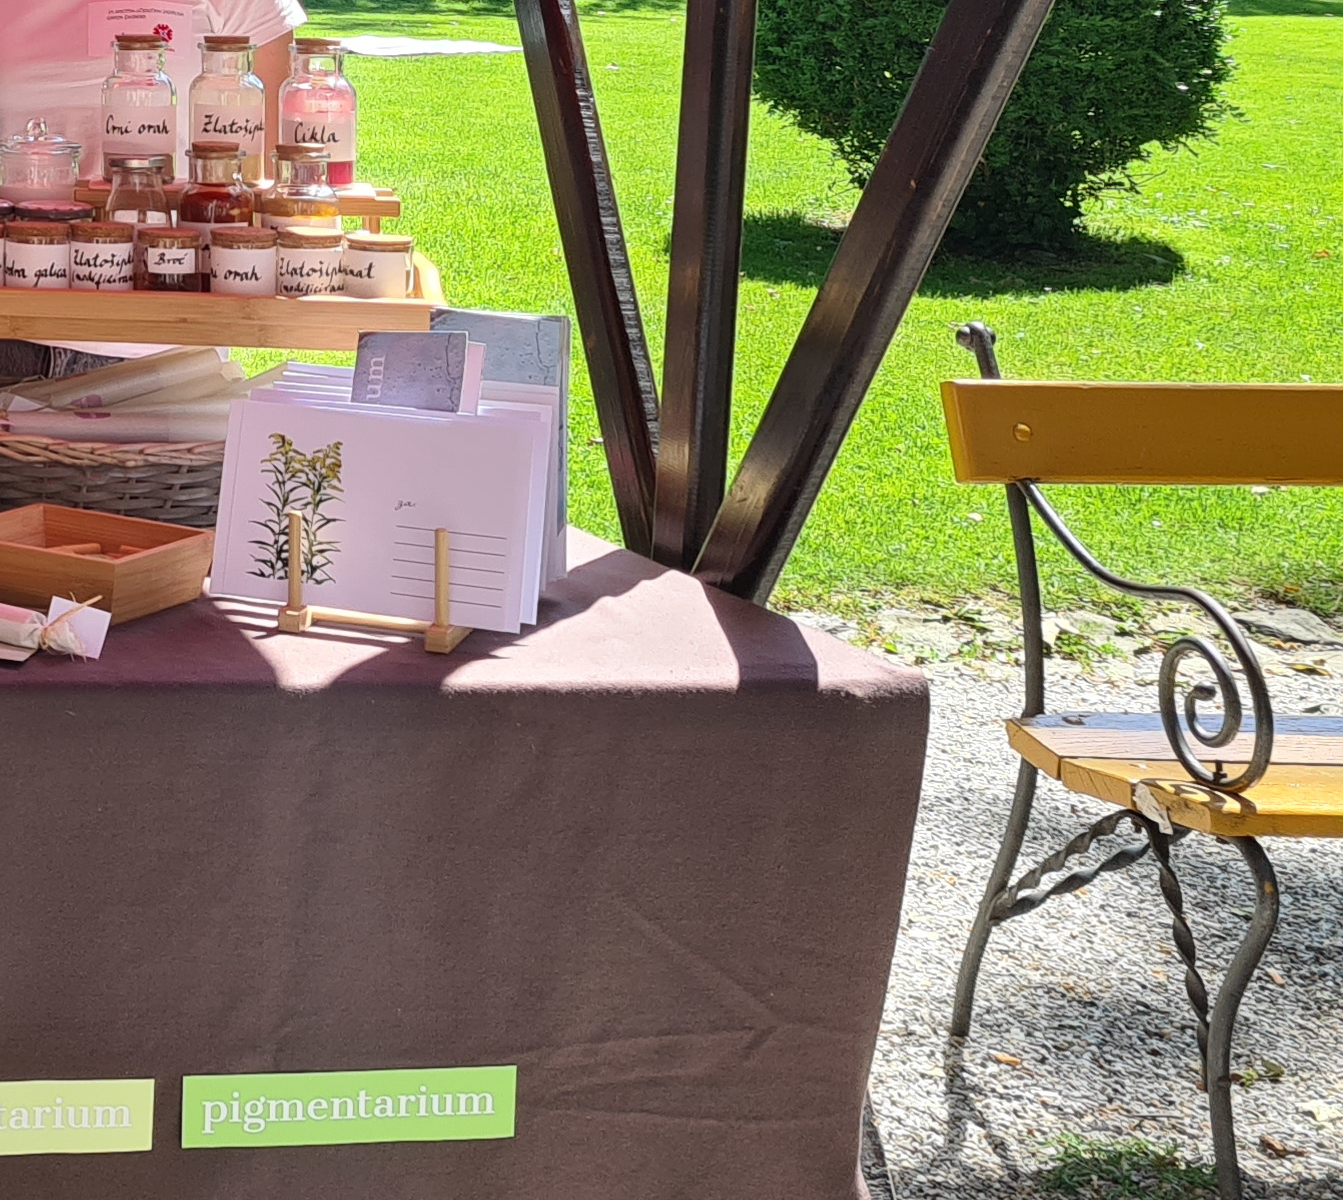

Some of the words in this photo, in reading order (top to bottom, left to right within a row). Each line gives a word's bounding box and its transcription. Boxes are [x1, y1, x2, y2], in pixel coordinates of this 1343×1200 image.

[106, 115, 132, 135] Crni
[138, 117, 170, 135] orah
[294, 122, 340, 144] Cikla
[224, 265, 262, 282] orah
[200, 1083, 496, 1132] pigmentarium
